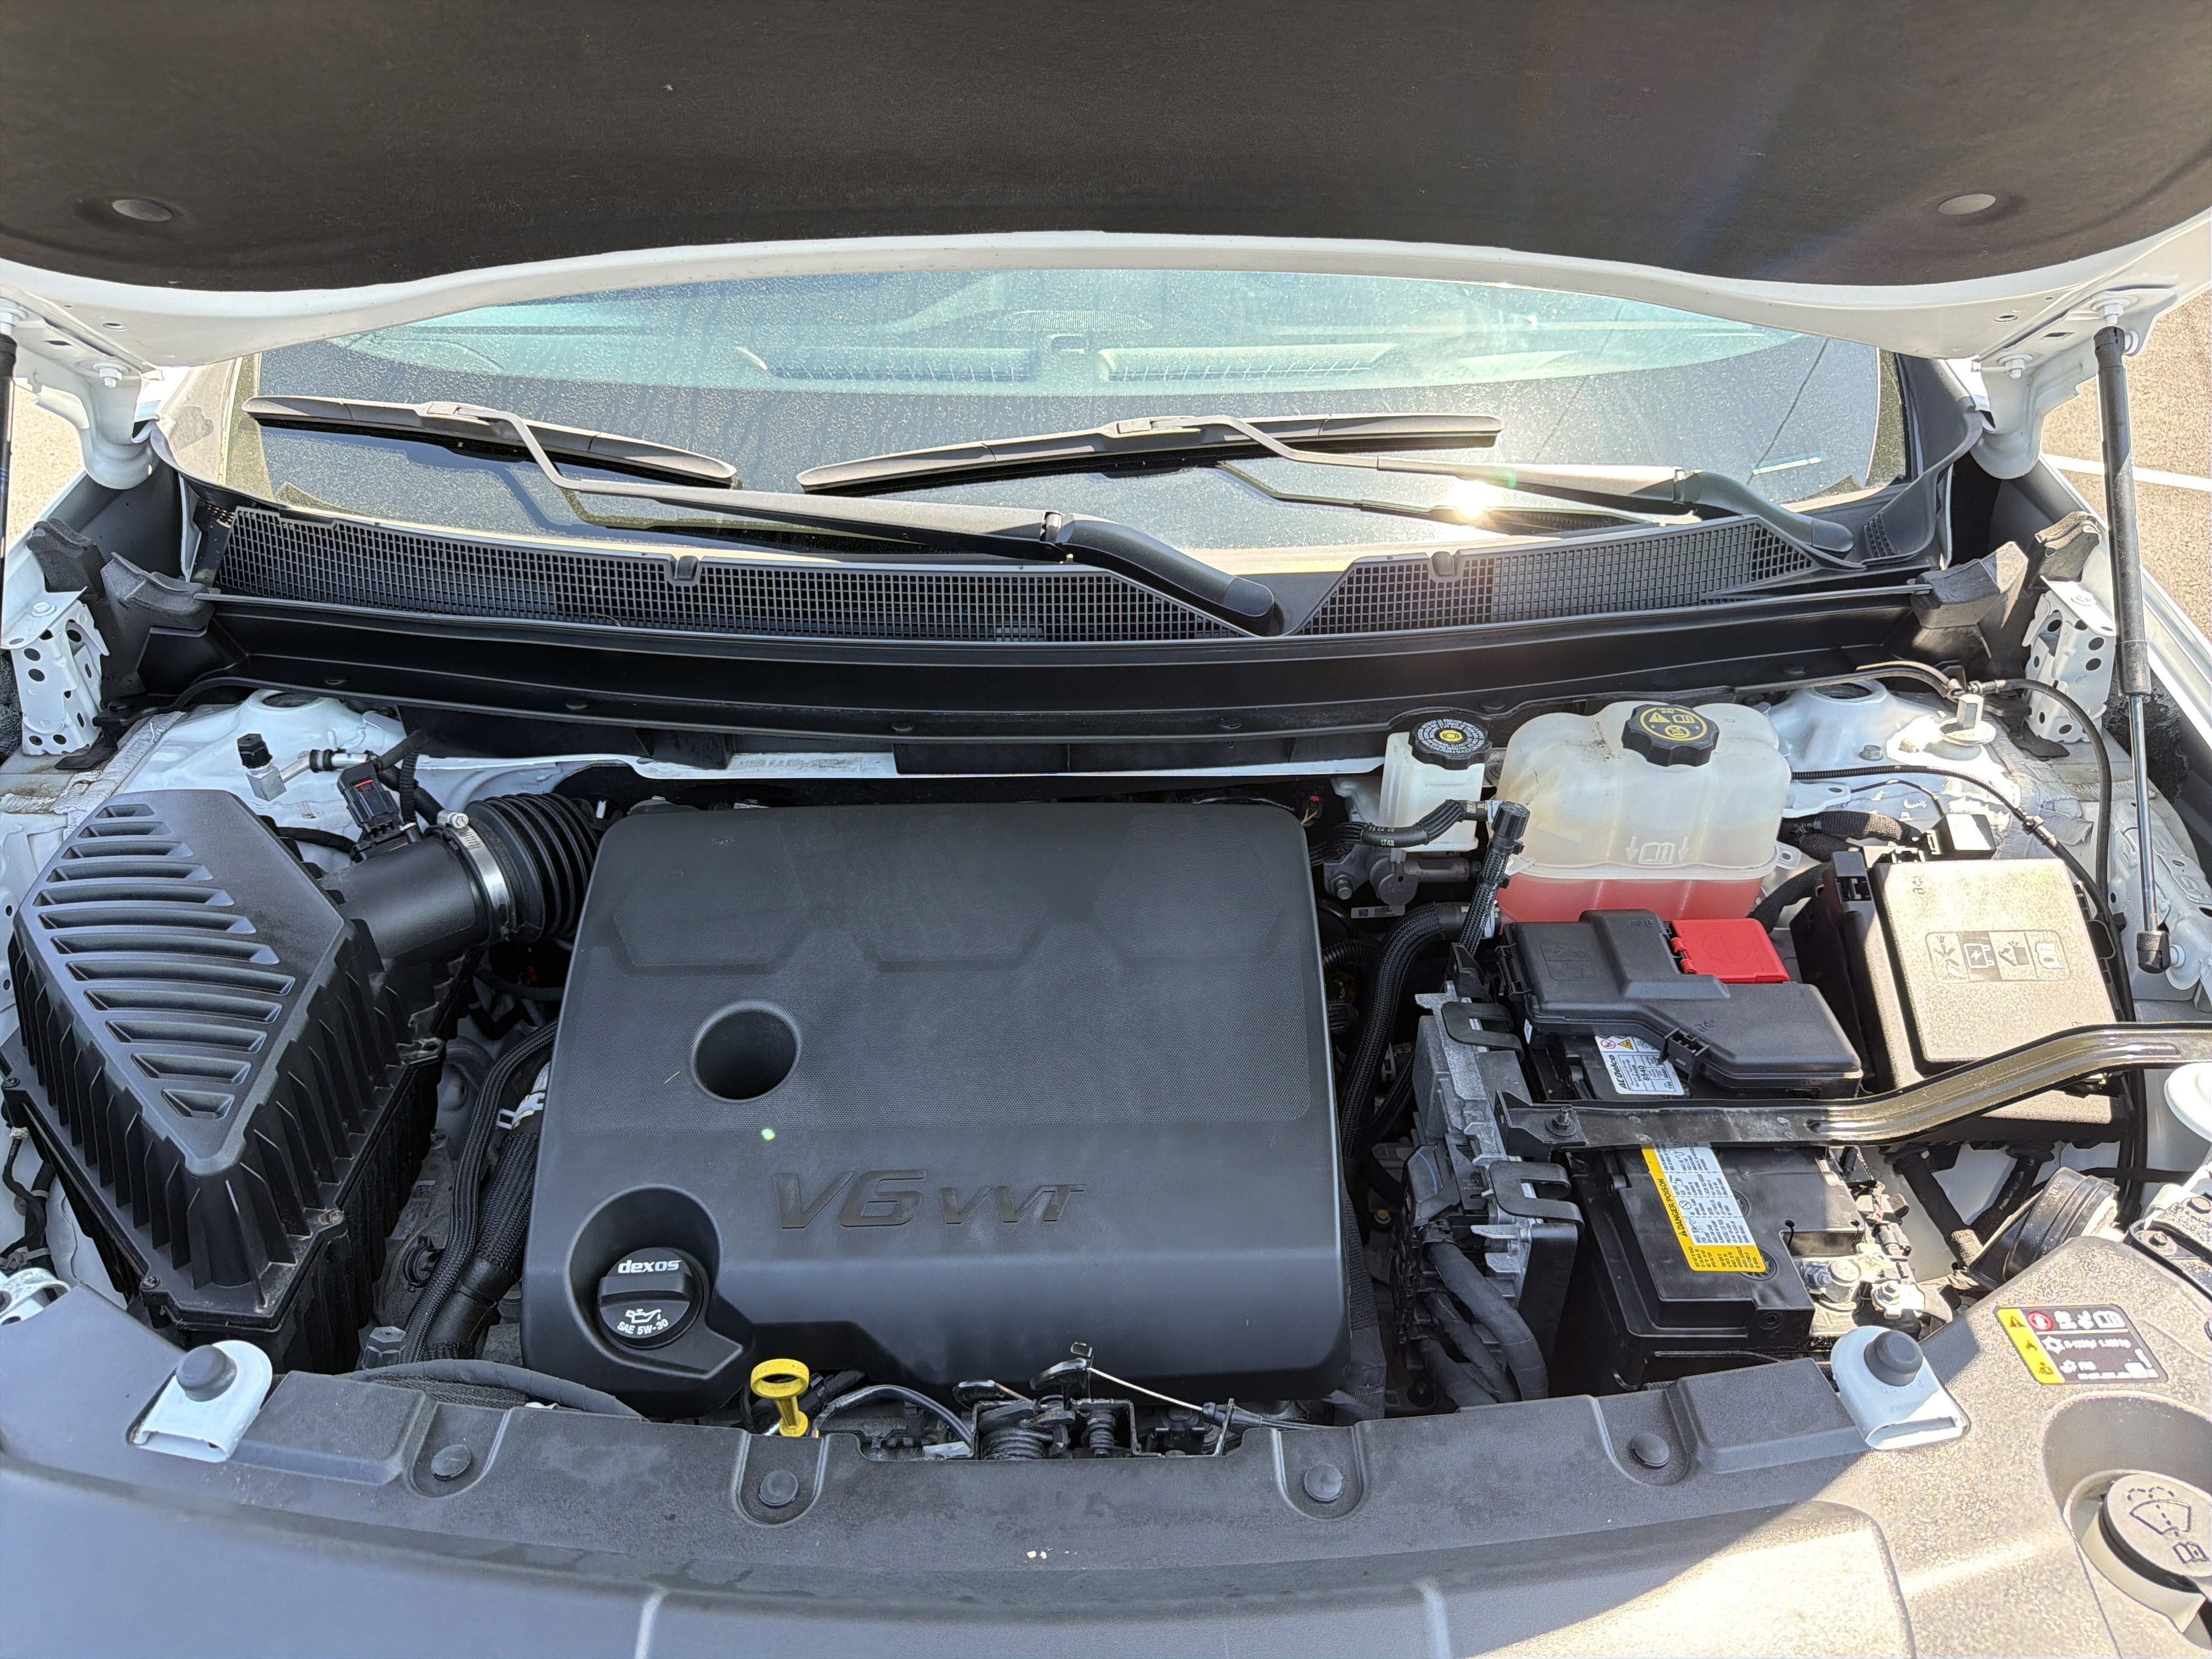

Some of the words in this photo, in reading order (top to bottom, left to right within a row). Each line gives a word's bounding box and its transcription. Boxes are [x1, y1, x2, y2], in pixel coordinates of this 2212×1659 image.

[1609, 1054, 1628, 1090] ACDelco
[1637, 1065, 1650, 1081] 8540
[774, 1169, 928, 1229] V6
[939, 1183, 1087, 1224] VVT
[1657, 1178, 1685, 1231] DANGER/POISON
[618, 1260, 681, 1273] dexos
[617, 1322, 635, 1334] SAE
[637, 1318, 669, 1335] 5W-30
